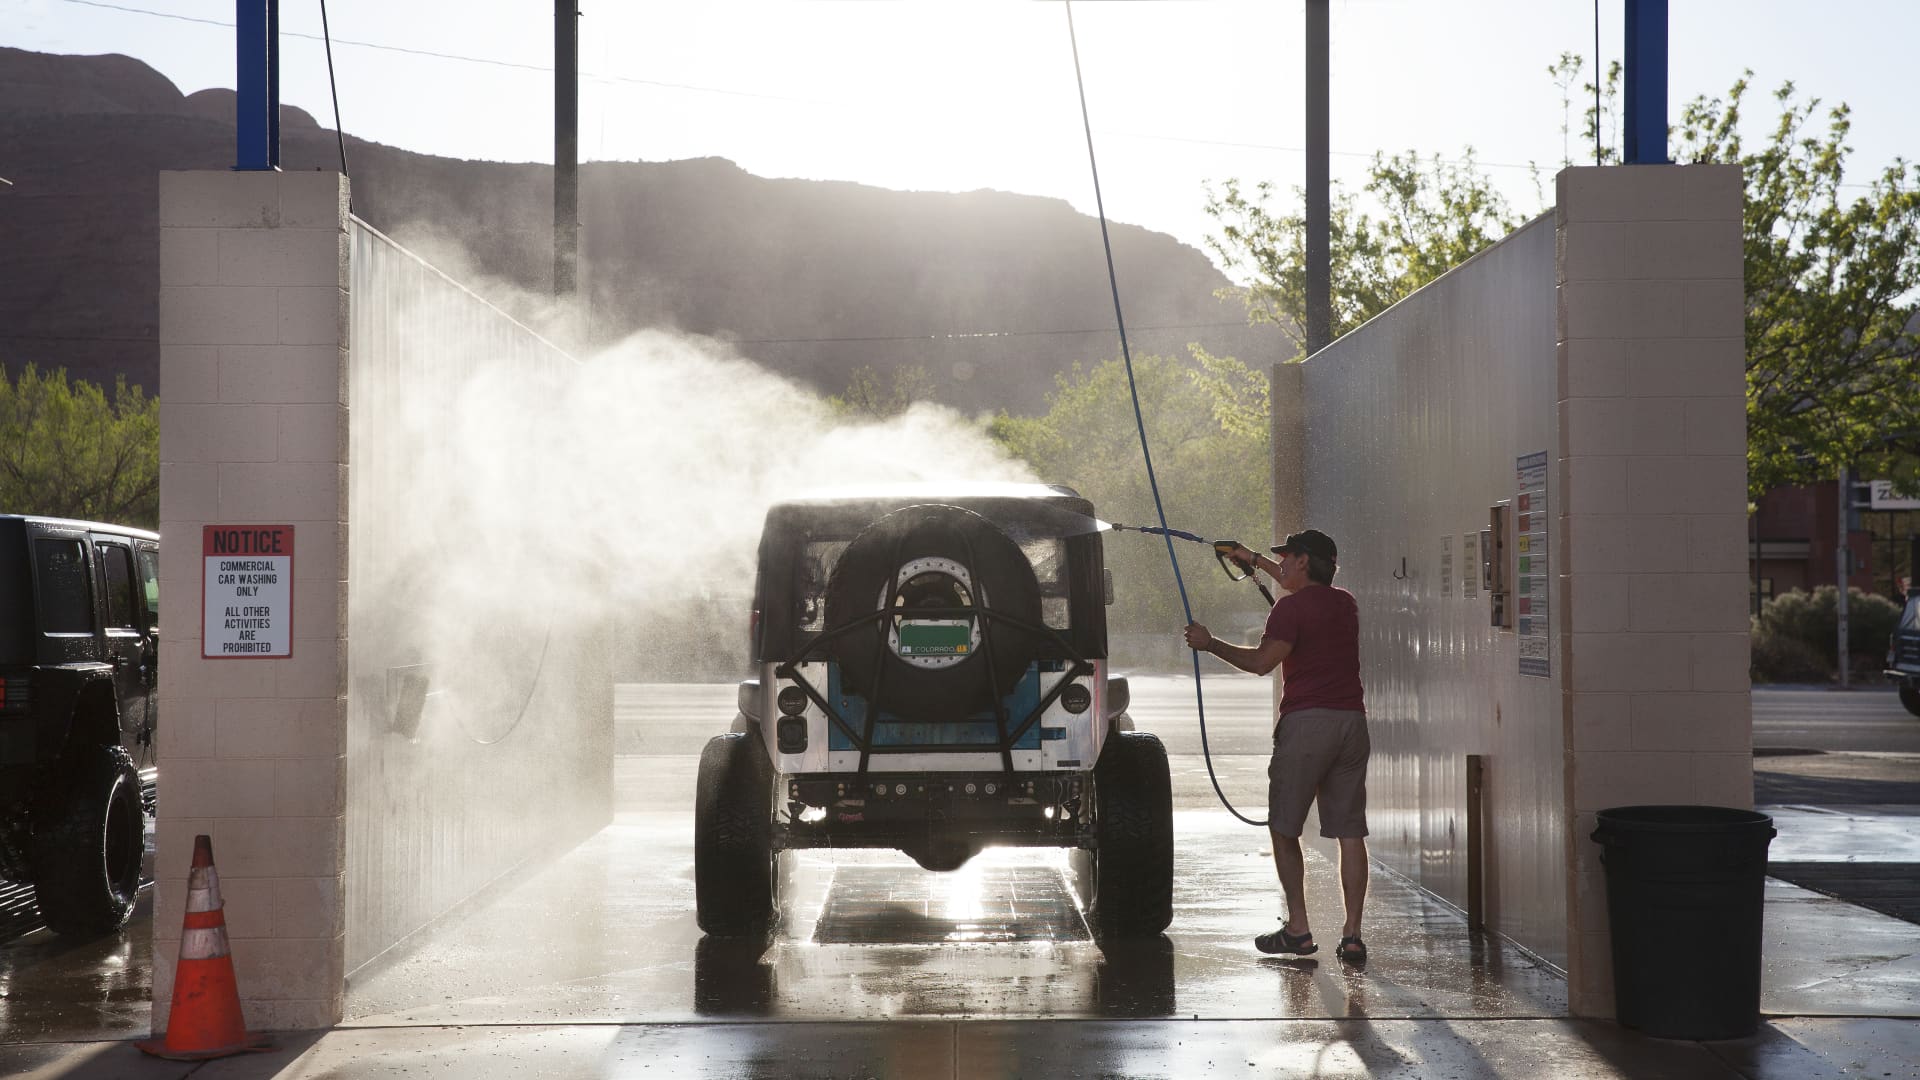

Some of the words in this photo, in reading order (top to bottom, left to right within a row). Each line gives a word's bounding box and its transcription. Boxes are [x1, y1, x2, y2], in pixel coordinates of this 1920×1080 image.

[213, 530, 283, 553] NOTICE
[220, 561, 275, 571] COMMERCIAL
[218, 574, 235, 584] CAR
[238, 574, 277, 584] WASHING
[236, 586, 259, 596] ONLY
[225, 606, 240, 617] ALL
[243, 606, 270, 617] OTHER
[224, 618, 270, 629] ACTIVITIES
[239, 630, 256, 641] ARE
[223, 642, 271, 653] PROHIBITED
